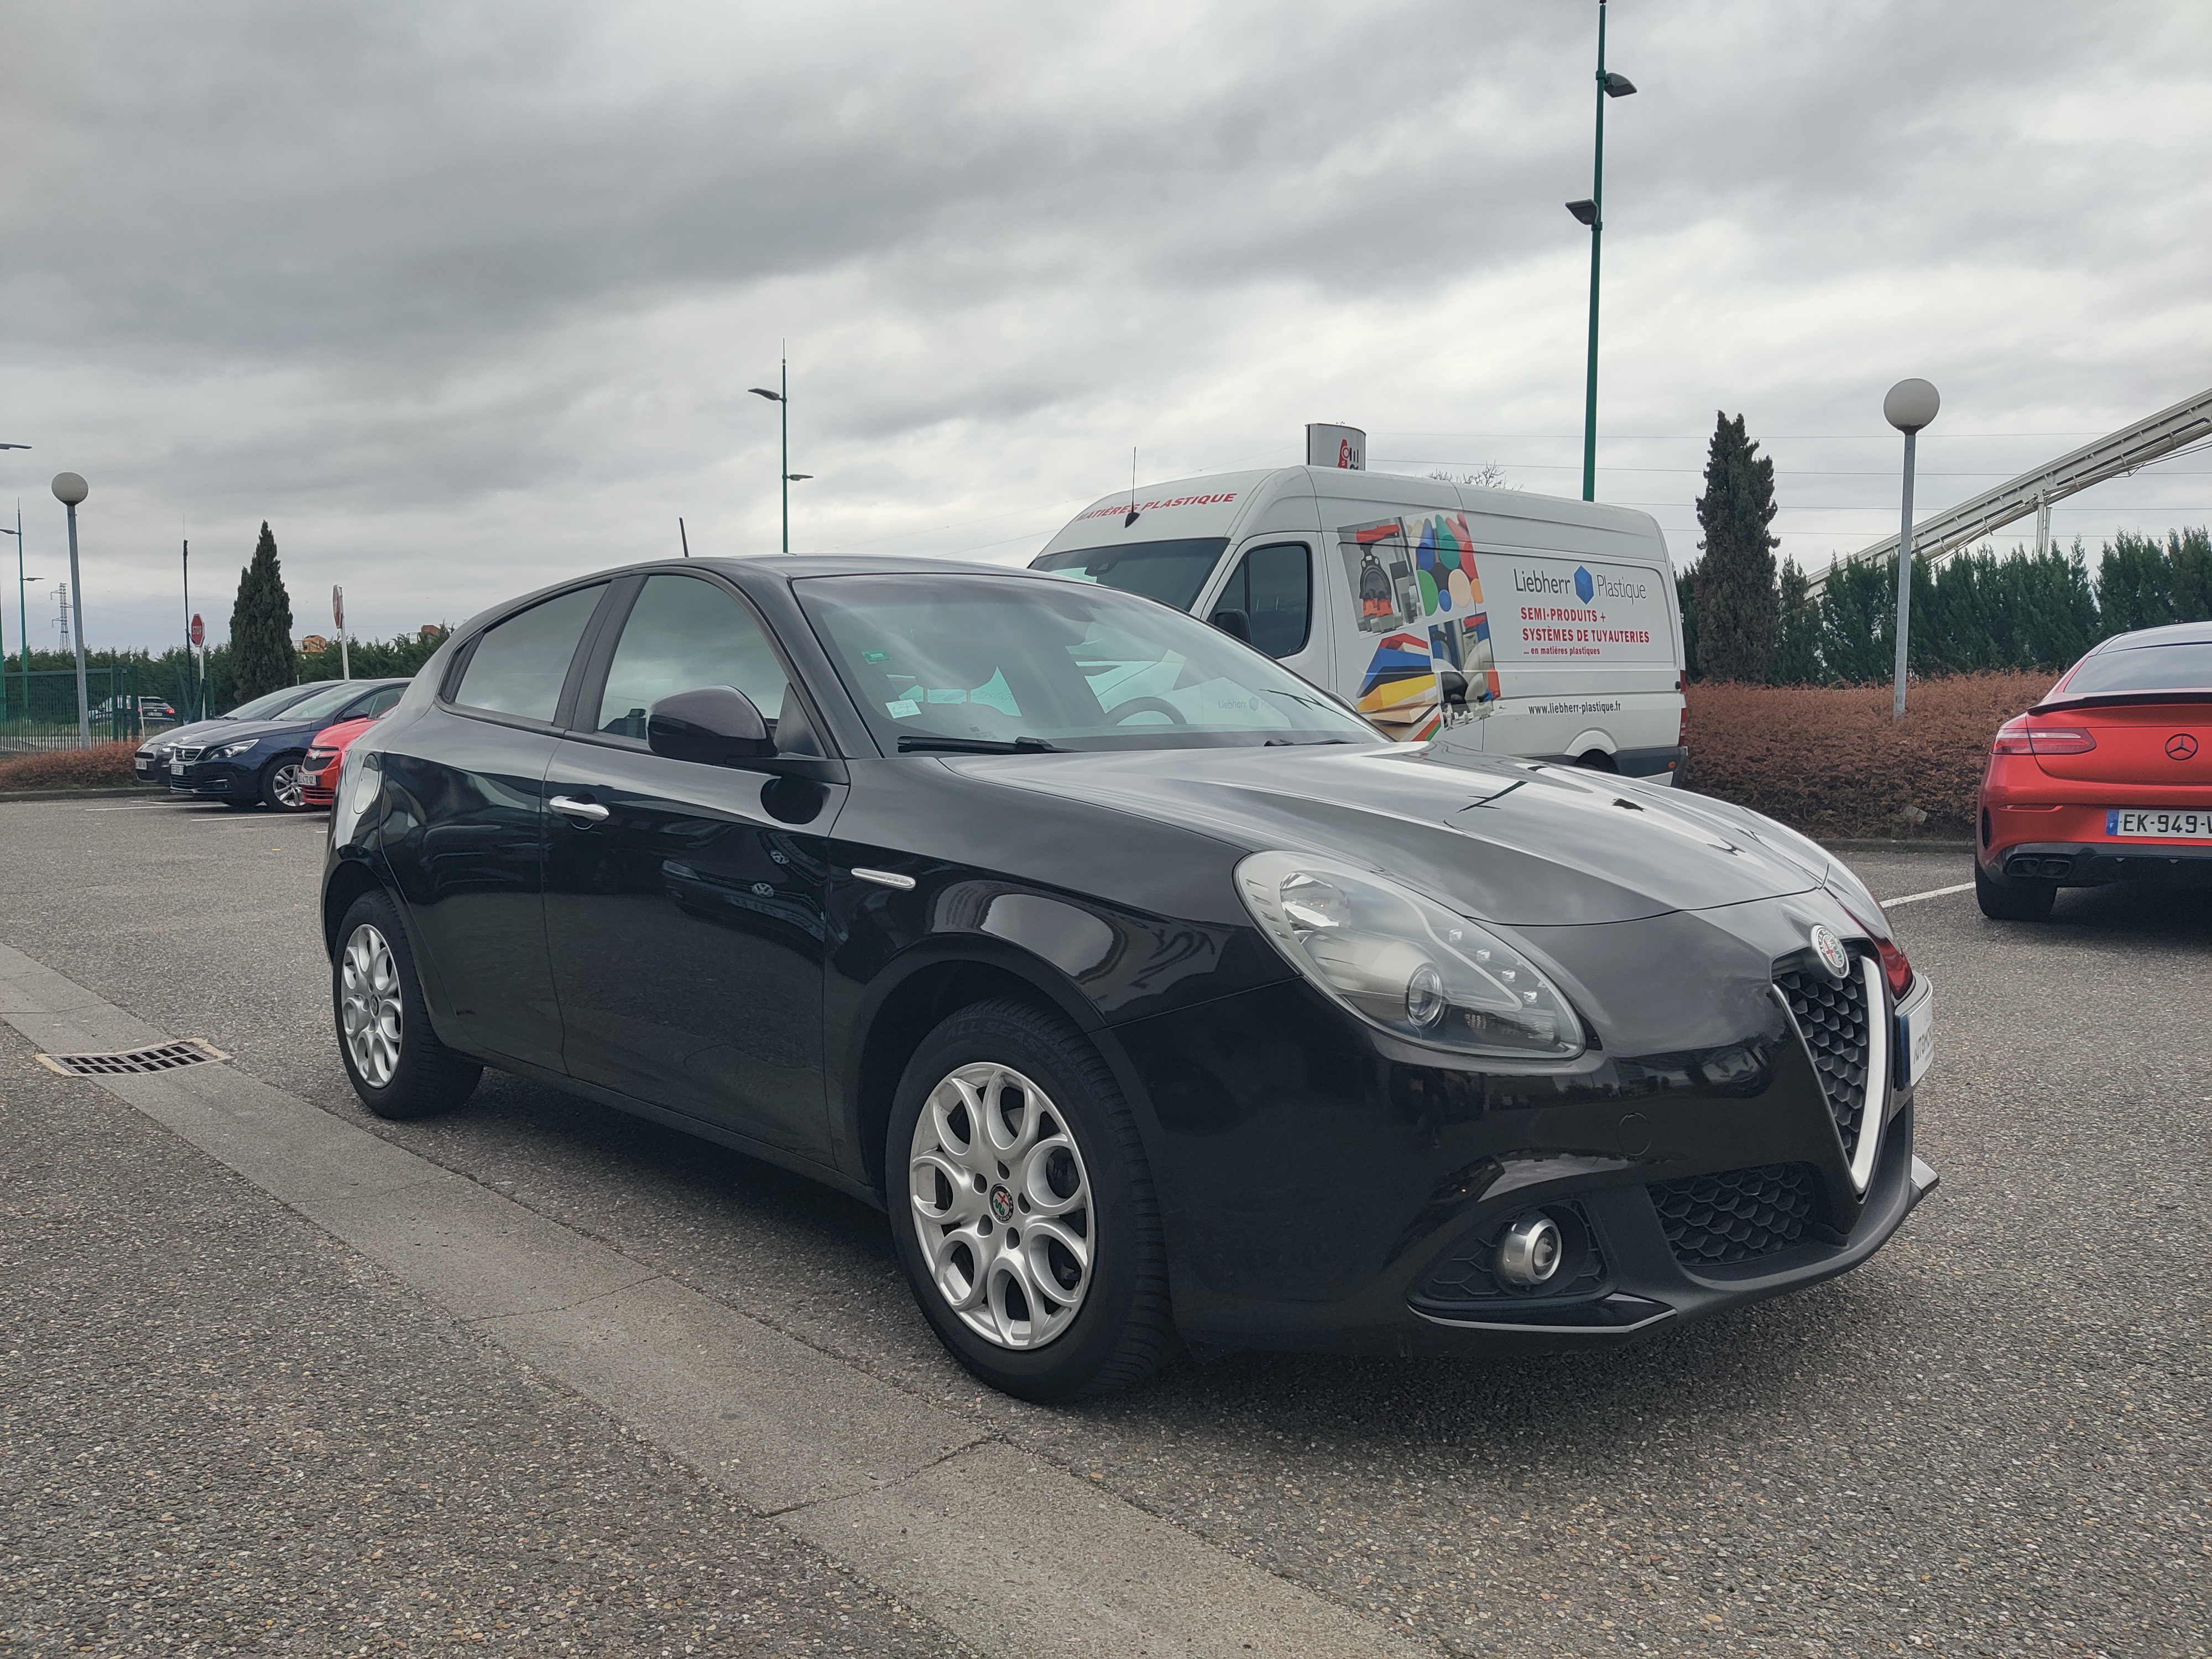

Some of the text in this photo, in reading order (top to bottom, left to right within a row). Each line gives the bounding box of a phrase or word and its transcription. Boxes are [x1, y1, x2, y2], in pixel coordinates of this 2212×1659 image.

[1141, 493, 1237, 511] PLASTIQUE
[1514, 568, 1646, 605] Liebherr Plastique
[1521, 607, 1597, 622] SEMI-PRODUITS
[192, 625, 202, 635] STOP
[1522, 625, 1650, 643] SYSTÈMES DE TUYAUTERIES
[1541, 646, 1568, 655] matières
[1569, 646, 1600, 656] plastiques
[1218, 699, 1247, 709] Liebherr
[1528, 700, 1621, 715] www.liebherr-plastique.fr
